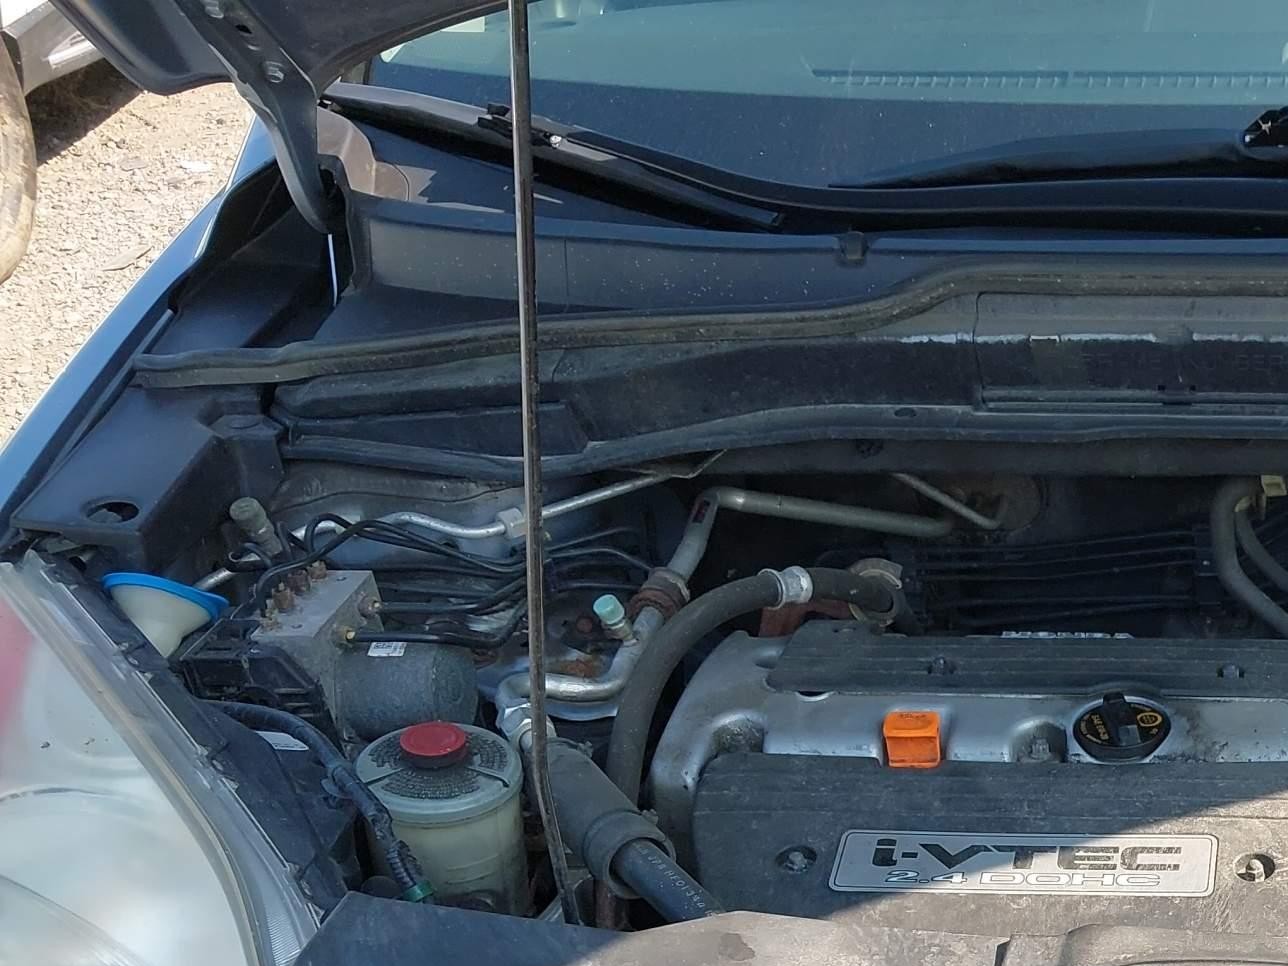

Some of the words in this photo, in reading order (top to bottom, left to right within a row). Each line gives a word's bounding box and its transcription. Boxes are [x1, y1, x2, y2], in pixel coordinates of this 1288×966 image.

[872, 838, 1182, 871] i-VTEC
[885, 870, 968, 883] 2.4
[979, 872, 1160, 887] DOHC
